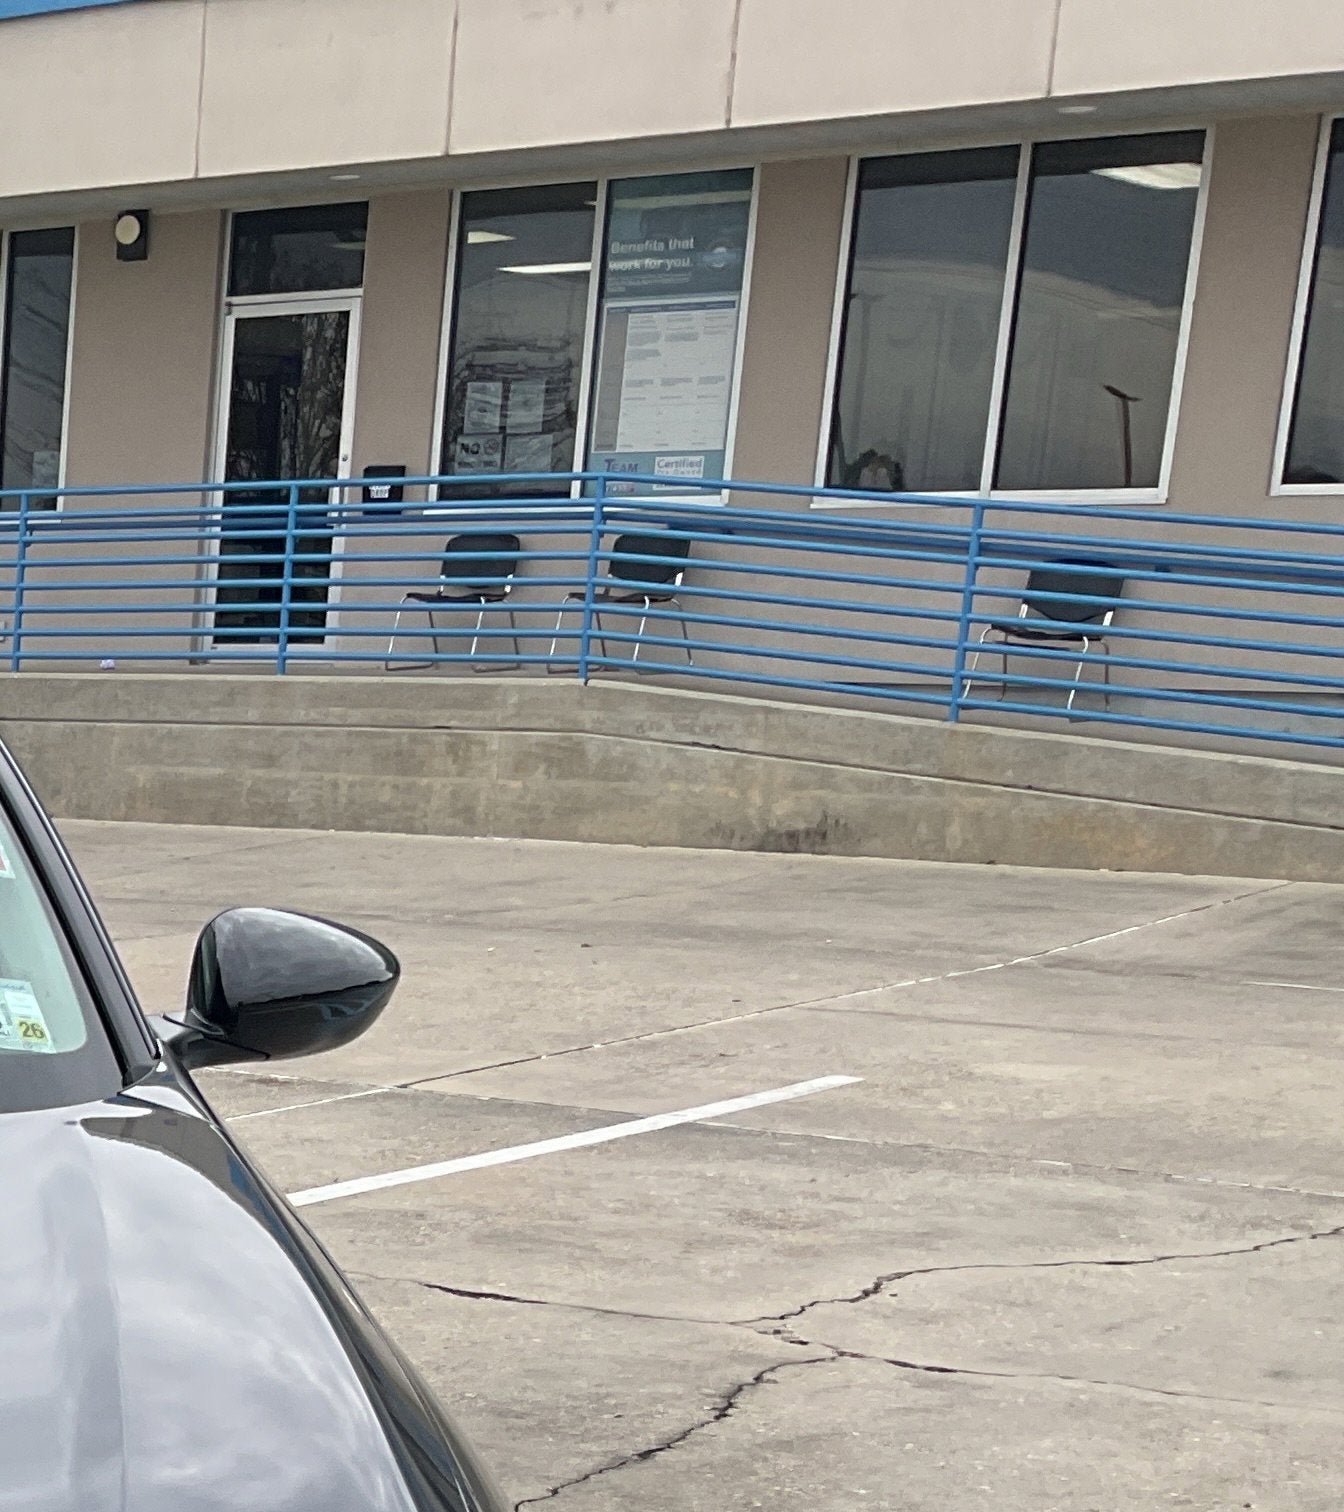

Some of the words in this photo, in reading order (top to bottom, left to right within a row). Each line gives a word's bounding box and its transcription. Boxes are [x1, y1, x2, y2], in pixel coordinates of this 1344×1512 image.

[611, 240, 665, 254] Benefits
[668, 236, 694, 250] that
[644, 257, 660, 270] for
[657, 457, 703, 469] Certified
[19, 1021, 45, 1039] 26
